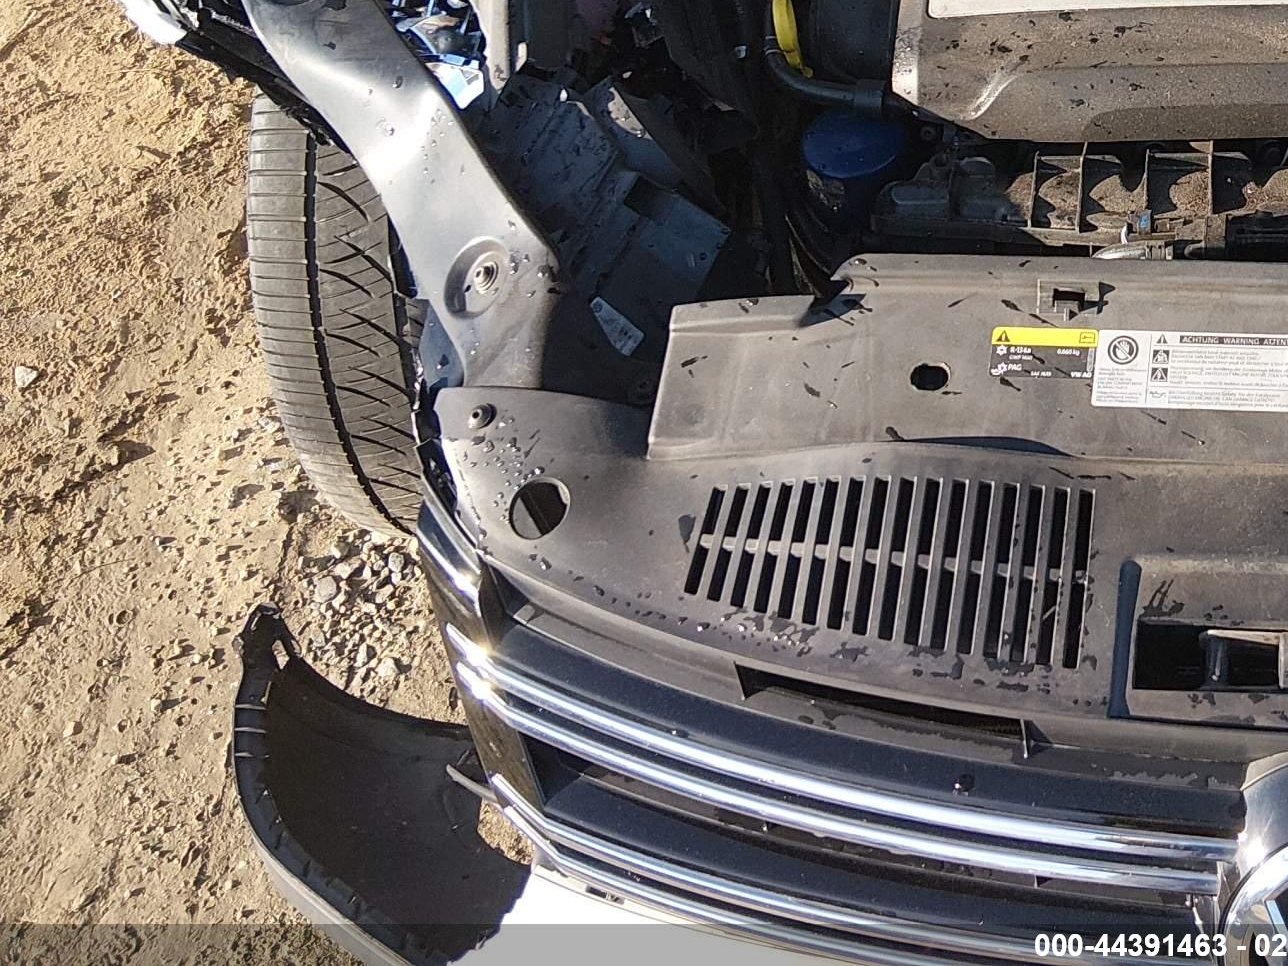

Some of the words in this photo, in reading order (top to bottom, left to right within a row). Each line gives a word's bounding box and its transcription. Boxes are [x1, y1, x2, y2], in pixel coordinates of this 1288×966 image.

[1182, 336, 1219, 344] ACHTUNG
[1223, 337, 1259, 345] WARNING
[1010, 346, 1032, 354] R-134a
[1008, 363, 1022, 371] PAG
